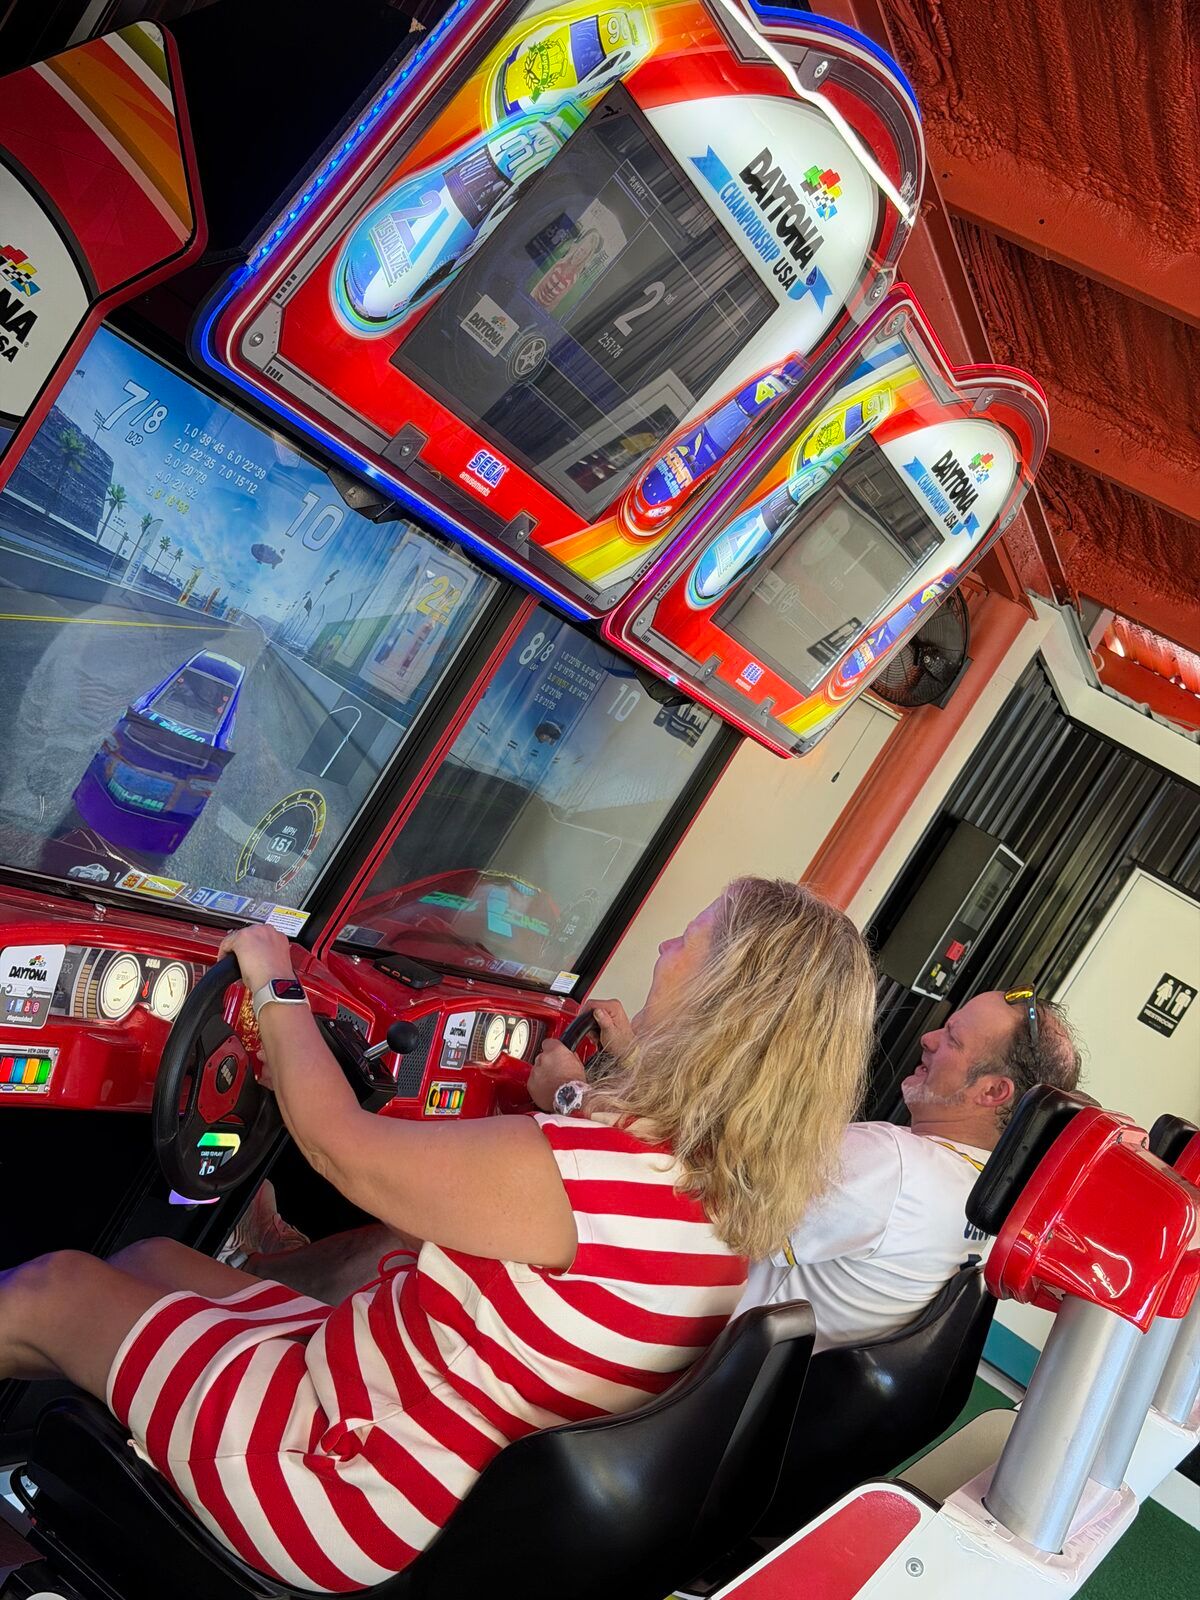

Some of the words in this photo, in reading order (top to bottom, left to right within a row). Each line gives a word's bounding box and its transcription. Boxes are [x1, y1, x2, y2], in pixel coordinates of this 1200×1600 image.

[738, 146, 825, 271] DAYTONA
[720, 181, 781, 264] CHAMPIONSHIP
[772, 256, 798, 292] USA
[467, 311, 505, 346] DAYTONA
[125, 430, 144, 447] LAP
[466, 449, 508, 488] SEGA
[931, 449, 979, 517] DAYTONA
[917, 473, 951, 517] CHAMPIONSHIP
[943, 510, 960, 532] USA
[285, 491, 345, 551] 10
[518, 631, 555, 666] 8/8
[606, 683, 641, 722] 10
[270, 836, 293, 853] 151
[281, 825, 298, 837] MPH
[264, 853, 281, 864] AUTO
[8, 966, 48, 982] DAYTONA
[1143, 1008, 1175, 1030] RESTROOM
